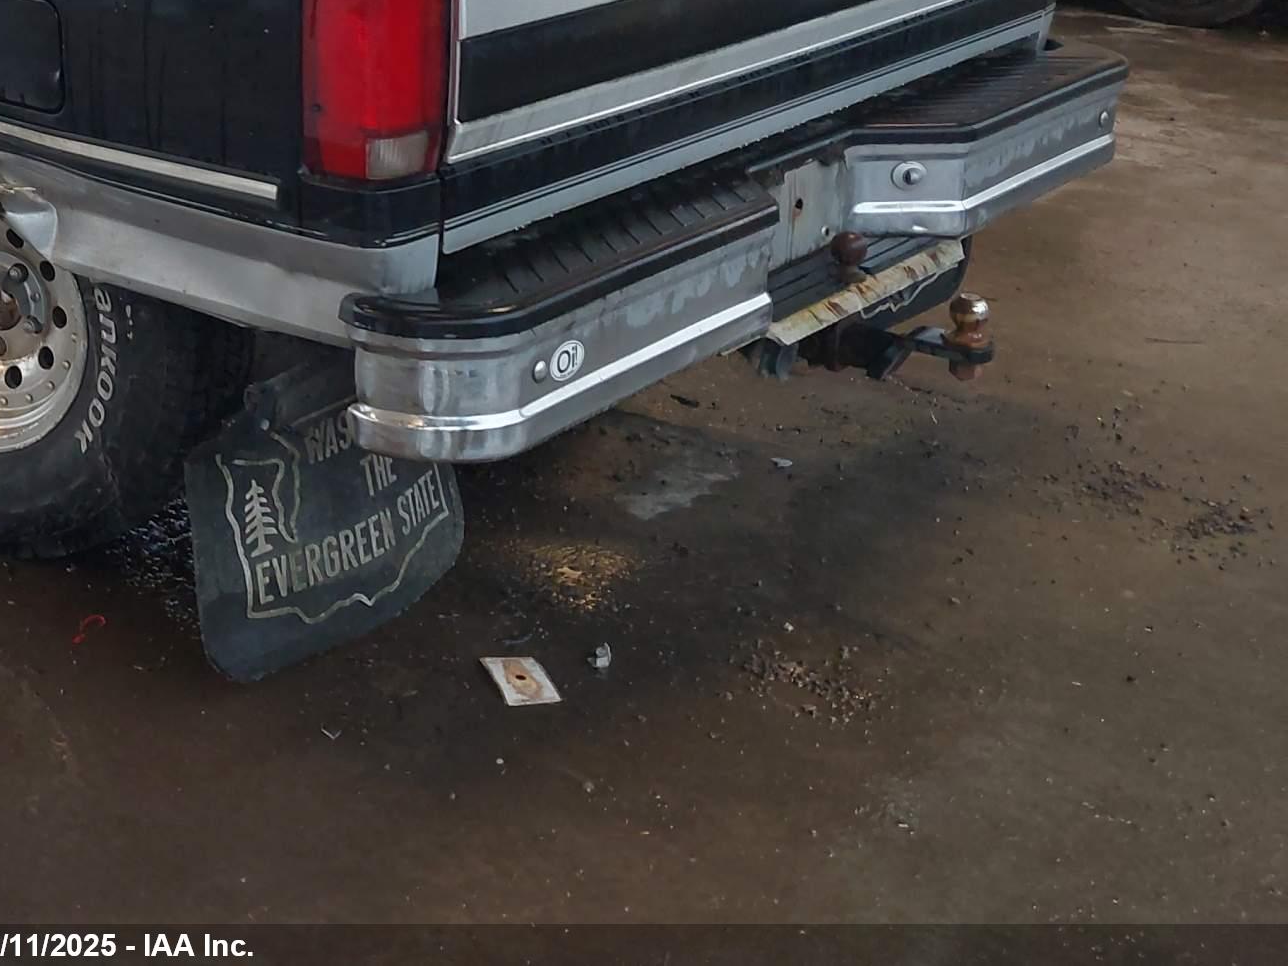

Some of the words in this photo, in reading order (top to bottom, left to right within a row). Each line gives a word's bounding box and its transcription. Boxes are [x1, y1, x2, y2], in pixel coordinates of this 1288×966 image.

[359, 453, 398, 496] THE
[255, 507, 396, 605] EVERGREEN
[397, 470, 440, 535] STATE
